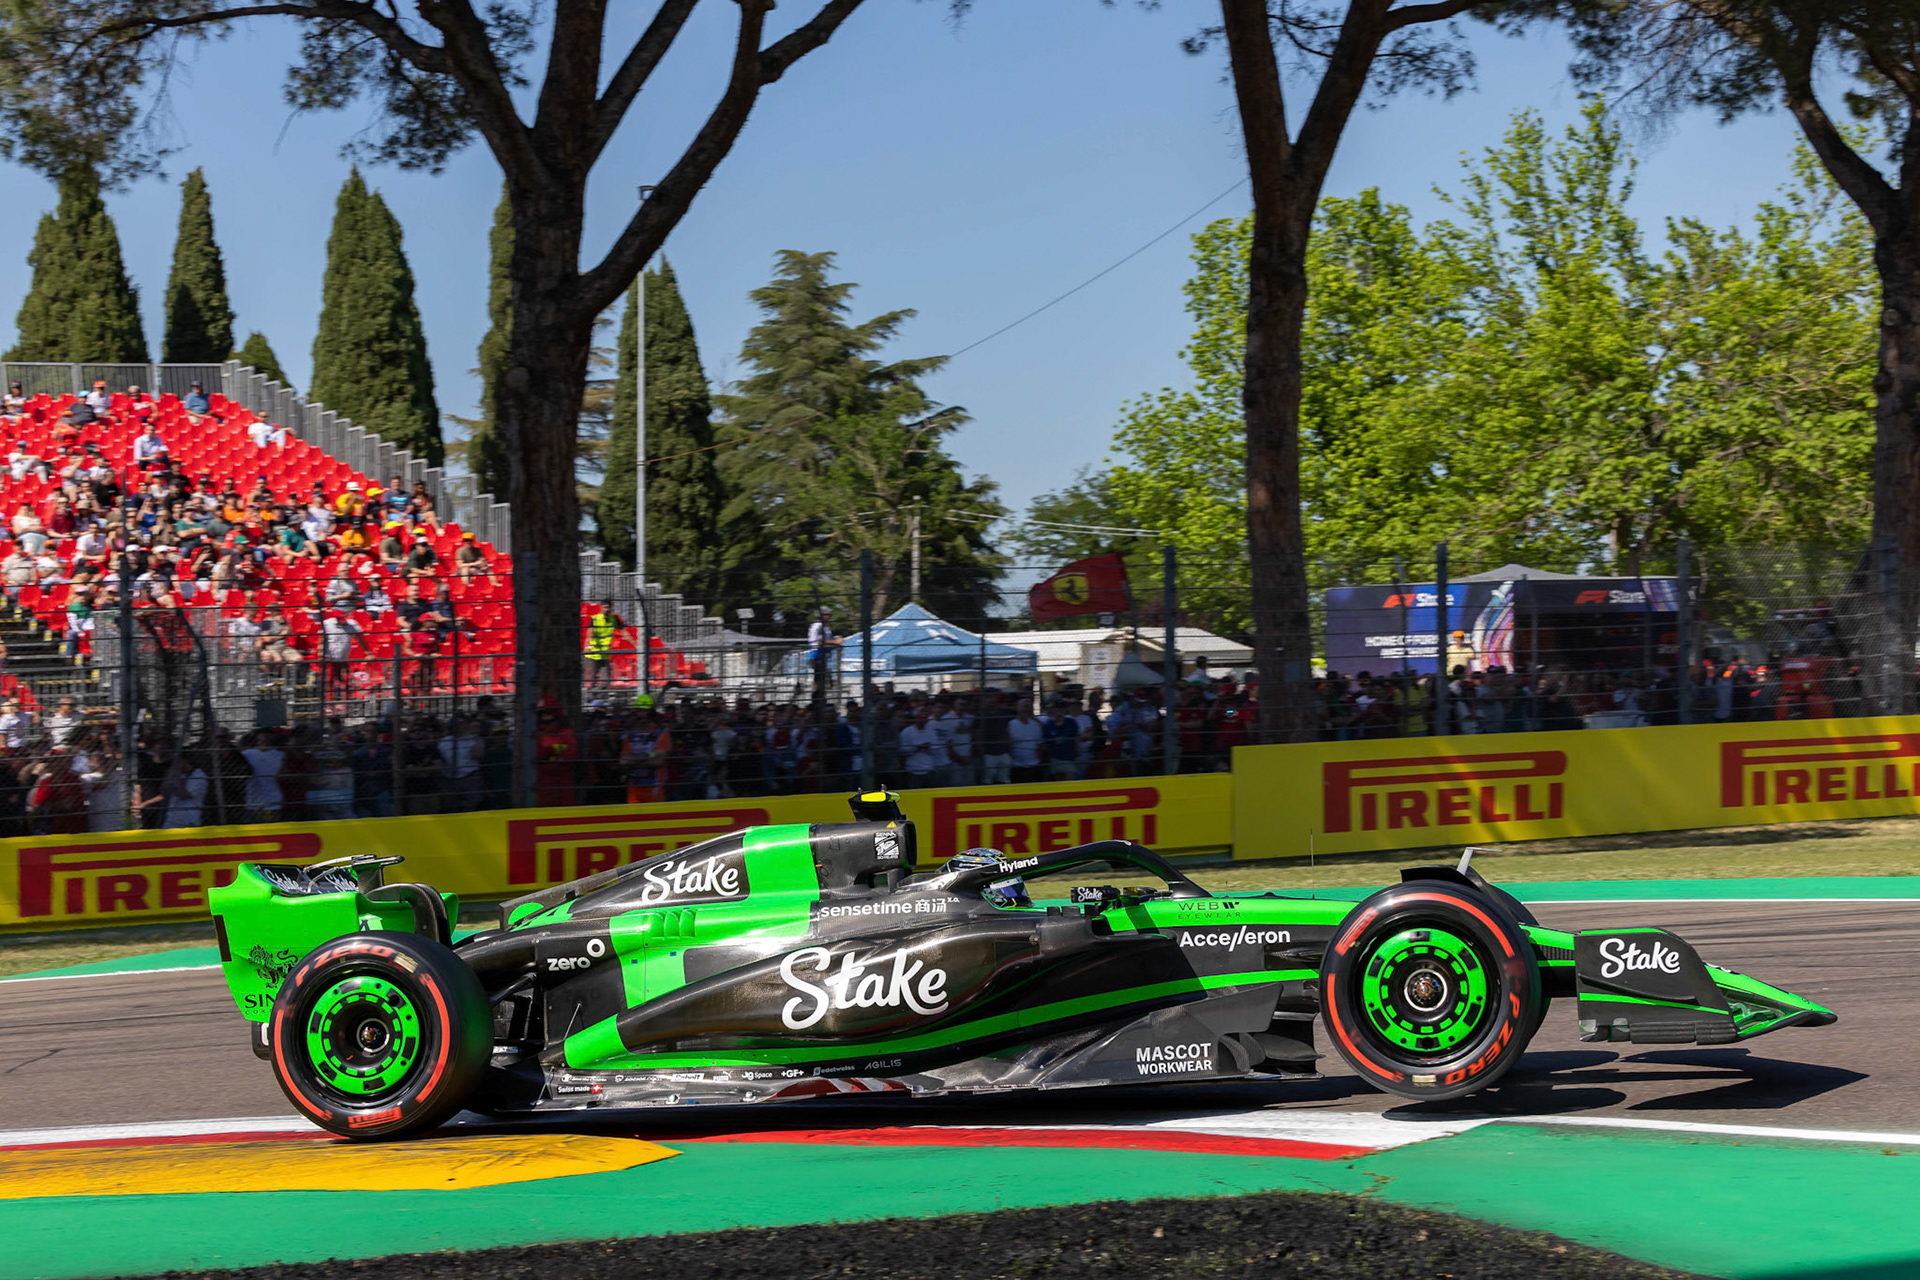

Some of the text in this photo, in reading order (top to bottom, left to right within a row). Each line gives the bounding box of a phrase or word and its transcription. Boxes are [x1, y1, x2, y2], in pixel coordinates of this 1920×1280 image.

[1415, 592, 1455, 607] Stoe
[1323, 750, 1568, 833] PIRELLI
[508, 808, 770, 885] PIRE
[999, 857, 1039, 873] Hyland
[17, 833, 321, 917] PIRE
[641, 856, 740, 903] Stake
[1077, 886, 1103, 902] Stake
[820, 901, 913, 917] sensetime
[1178, 902, 1219, 911] WEB
[1178, 912, 1242, 920] EYEWEAR
[1599, 937, 1681, 979] Stake
[779, 947, 949, 1030] Stake
[1136, 1042, 1212, 1063] MASCOT
[1444, 1019, 1524, 1086] ZERO
[821, 1065, 855, 1073] edelweiss
[864, 1058, 902, 1070] AGILIS
[1137, 1059, 1213, 1075] WORKWEAR
[557, 1086, 574, 1094] Swiss
